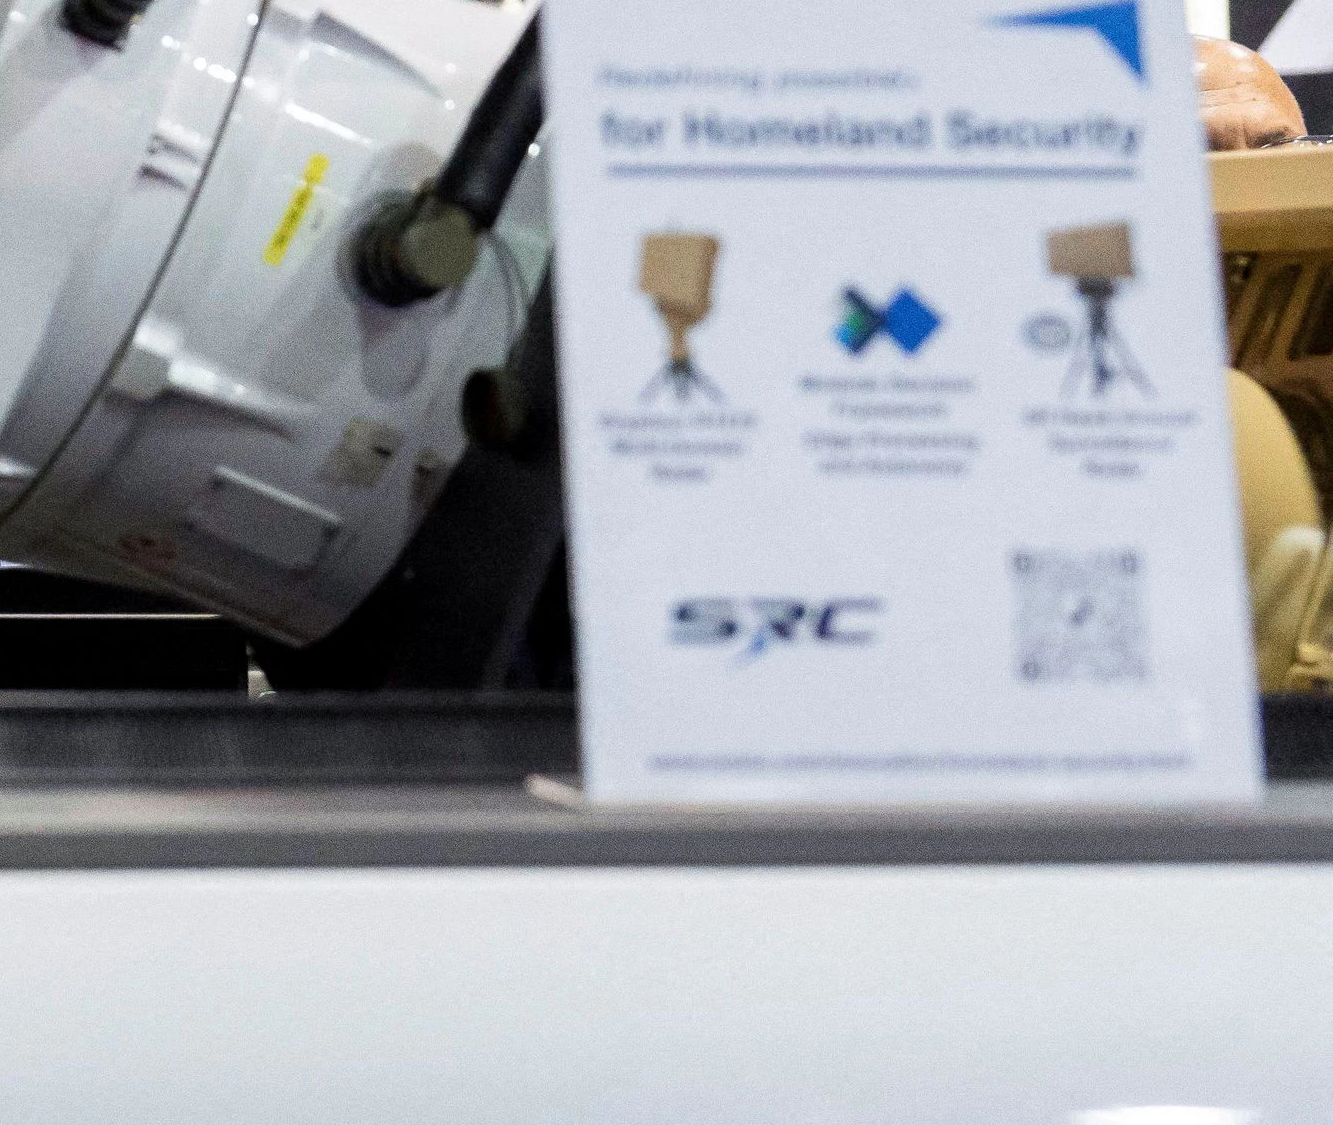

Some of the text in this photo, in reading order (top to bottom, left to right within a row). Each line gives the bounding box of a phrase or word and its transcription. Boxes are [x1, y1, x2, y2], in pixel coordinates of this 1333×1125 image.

[599, 109, 1140, 156] for Homeland Security
[668, 596, 885, 653] SRC
